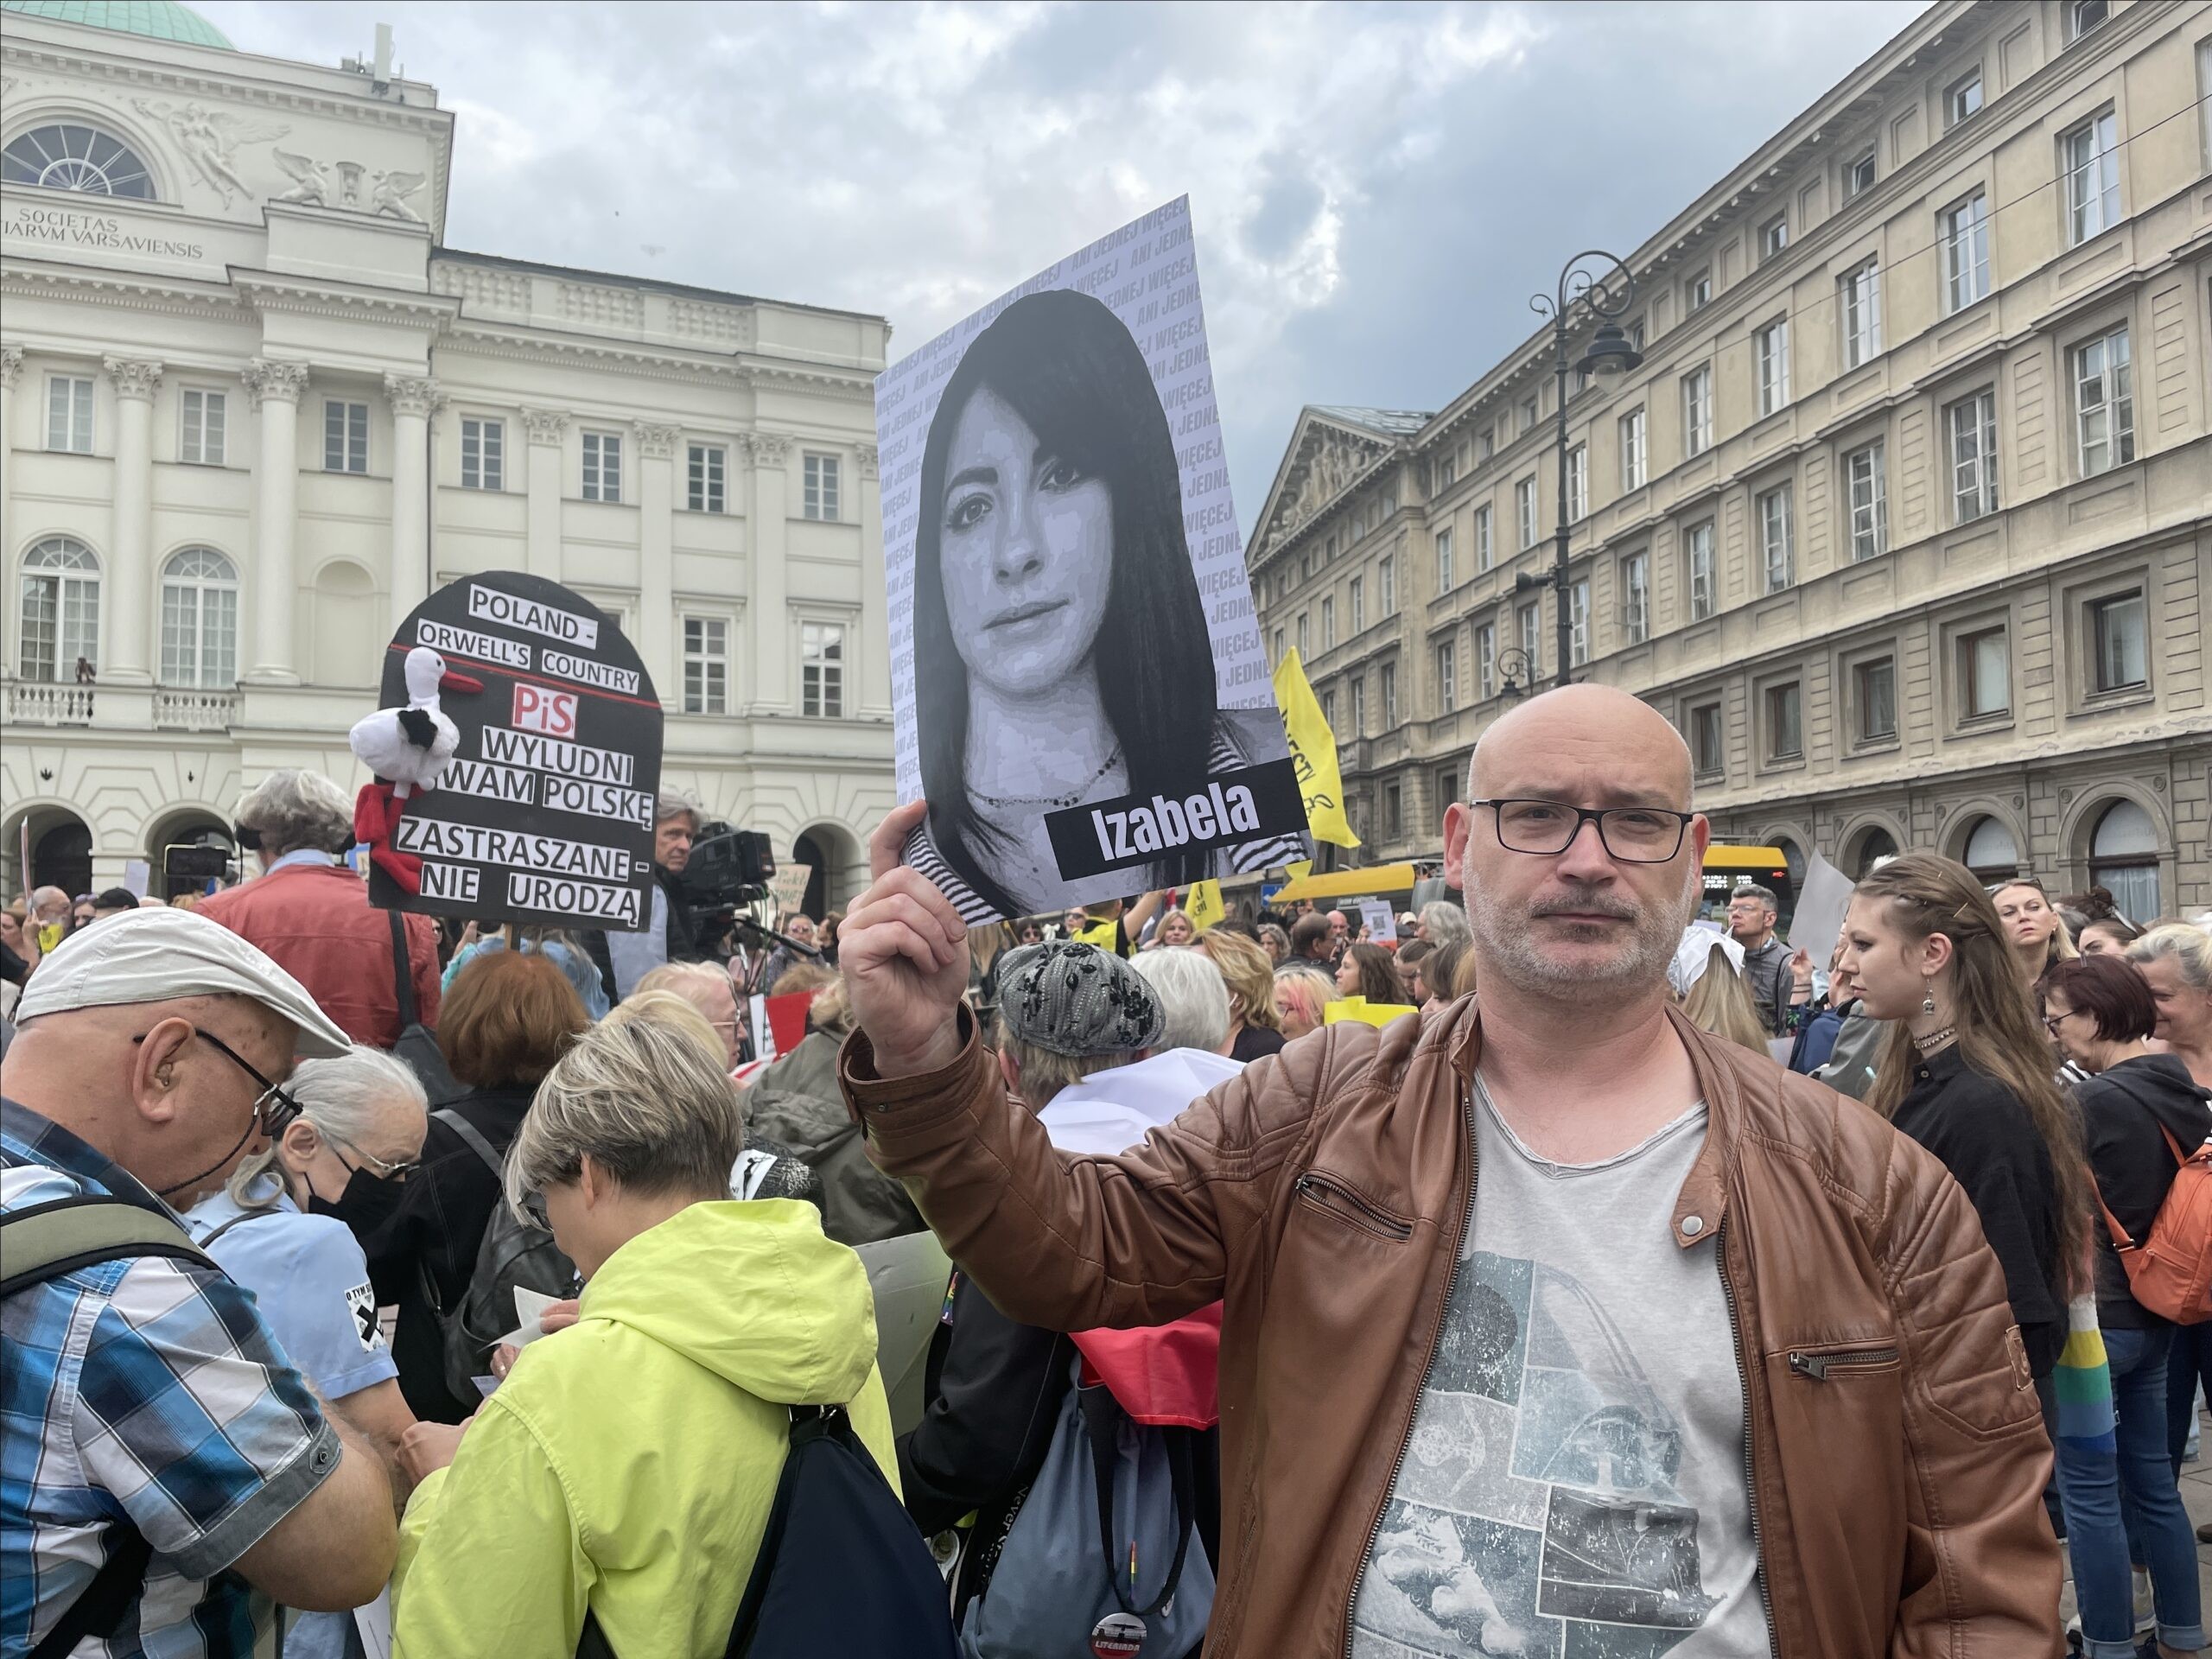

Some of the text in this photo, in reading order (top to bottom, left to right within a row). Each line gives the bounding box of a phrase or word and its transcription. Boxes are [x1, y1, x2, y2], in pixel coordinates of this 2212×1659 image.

[3, 220, 203, 259] IARVM VARSAVIENSIS
[19, 208, 118, 232] SOCIETAS
[1071, 245, 1091, 272] ANI
[1094, 220, 1138, 258] JEDNEJ
[1141, 194, 1188, 234] WIĘCEJ
[1077, 258, 1119, 294] WIĘCEJ
[1130, 241, 1152, 270] ANI
[1148, 252, 1195, 292] WIĘCEJ
[1137, 300, 1158, 327] ANI
[1155, 313, 1204, 352] WIĘCEJ
[1163, 374, 1212, 411] WIĘCEJ
[472, 590, 578, 639] POLAND
[419, 623, 639, 691] ORWELL'S COUNTRY
[514, 686, 575, 734] PiS
[485, 728, 632, 784] WYLUDNI
[443, 761, 652, 829] WAM POLSKĘ
[1092, 782, 1261, 861] Izabela
[398, 818, 628, 880] ZASTRASZANE
[422, 867, 639, 926] NIE URODZĄ
[352, 1285, 365, 1298] TYM
